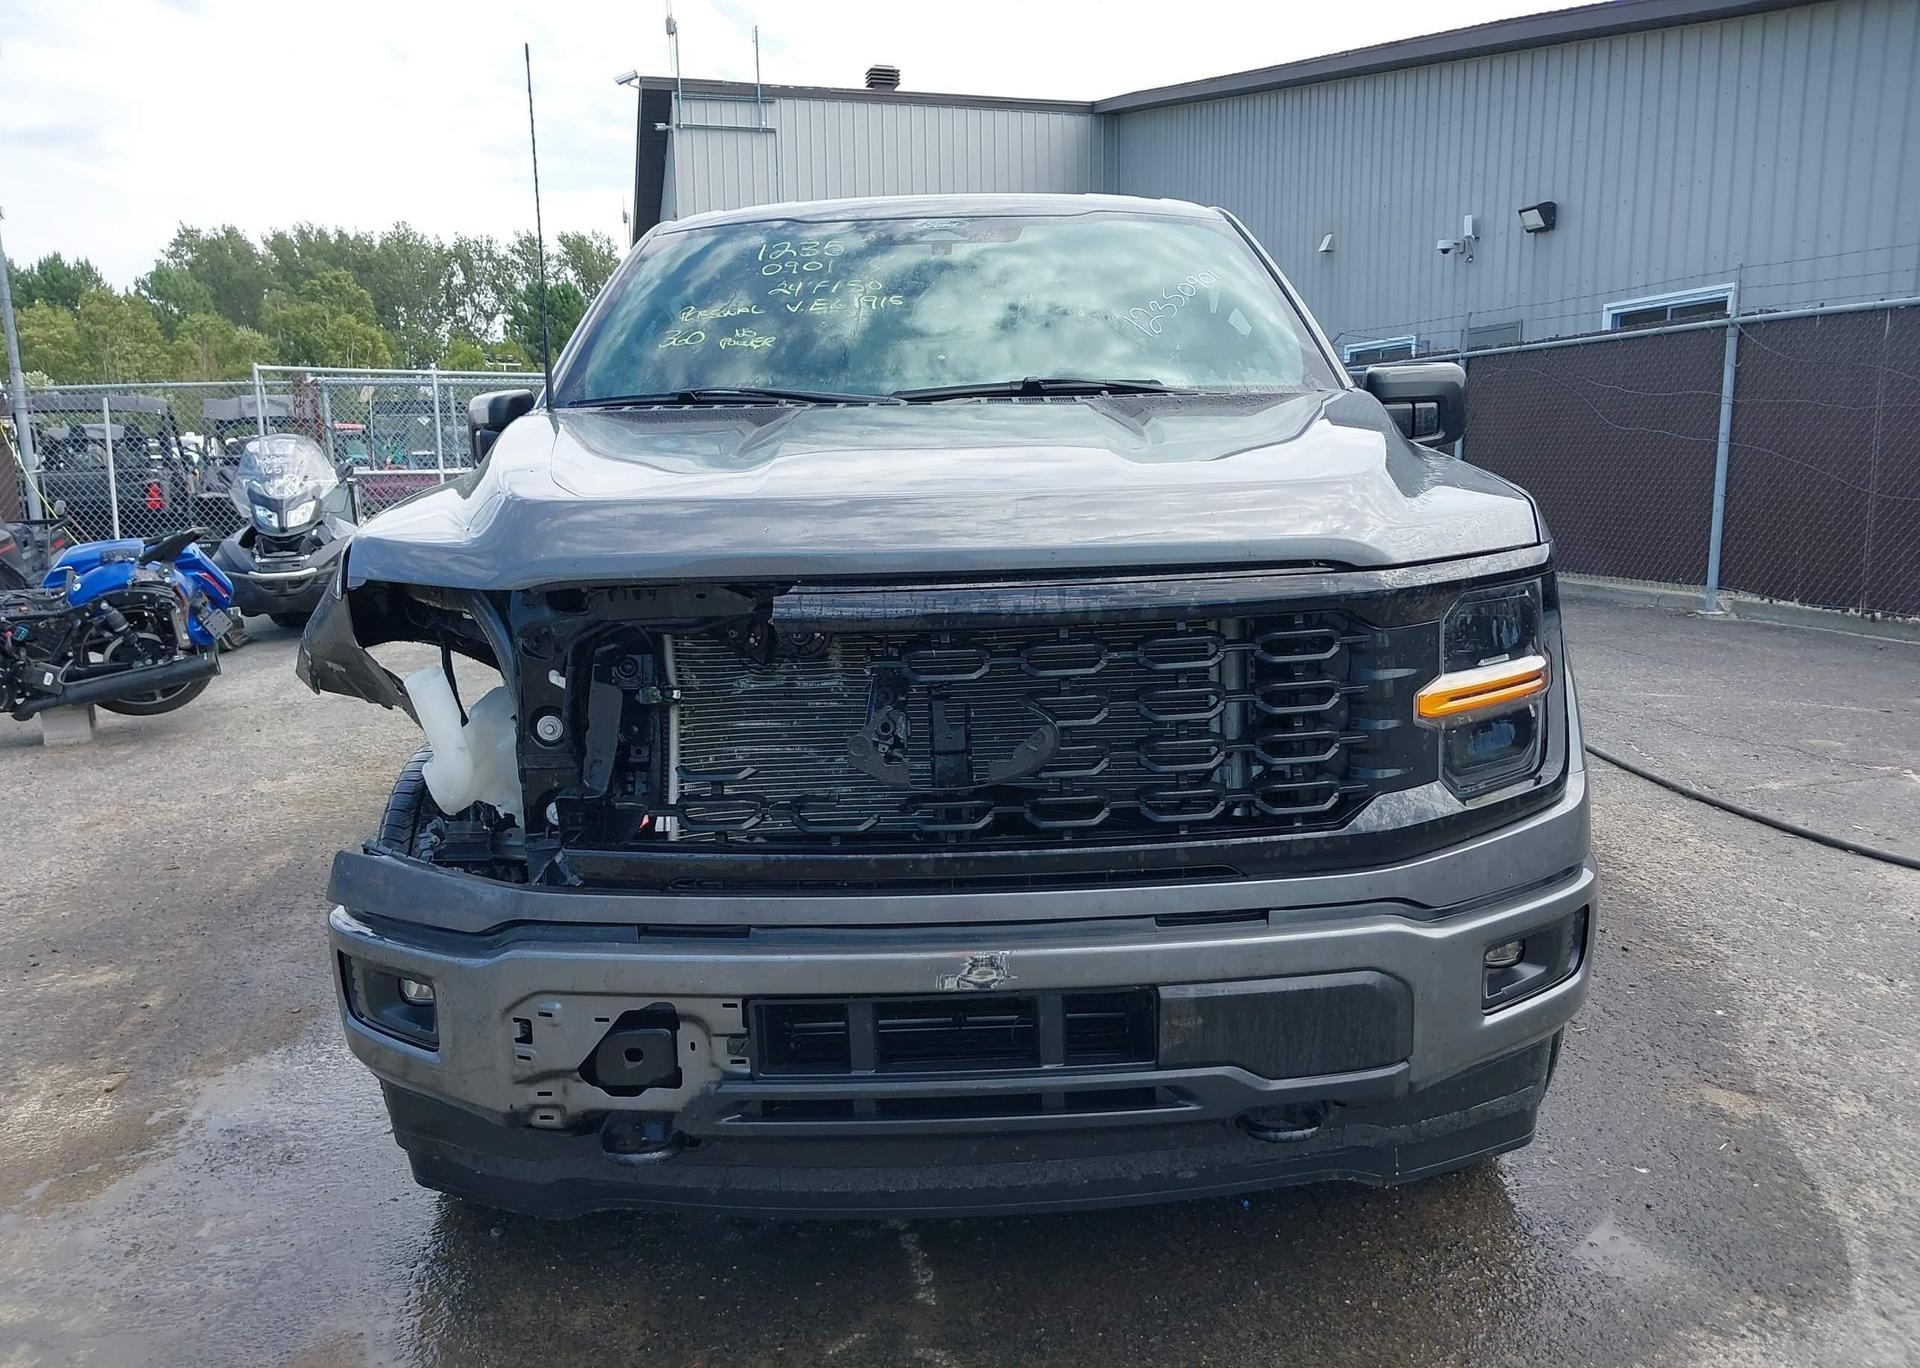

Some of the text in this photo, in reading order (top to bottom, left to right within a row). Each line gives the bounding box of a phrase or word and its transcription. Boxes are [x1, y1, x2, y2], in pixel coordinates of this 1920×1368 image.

[758, 241, 844, 261] 1235
[762, 260, 833, 275] 0901
[768, 280, 882, 297] 24 F150
